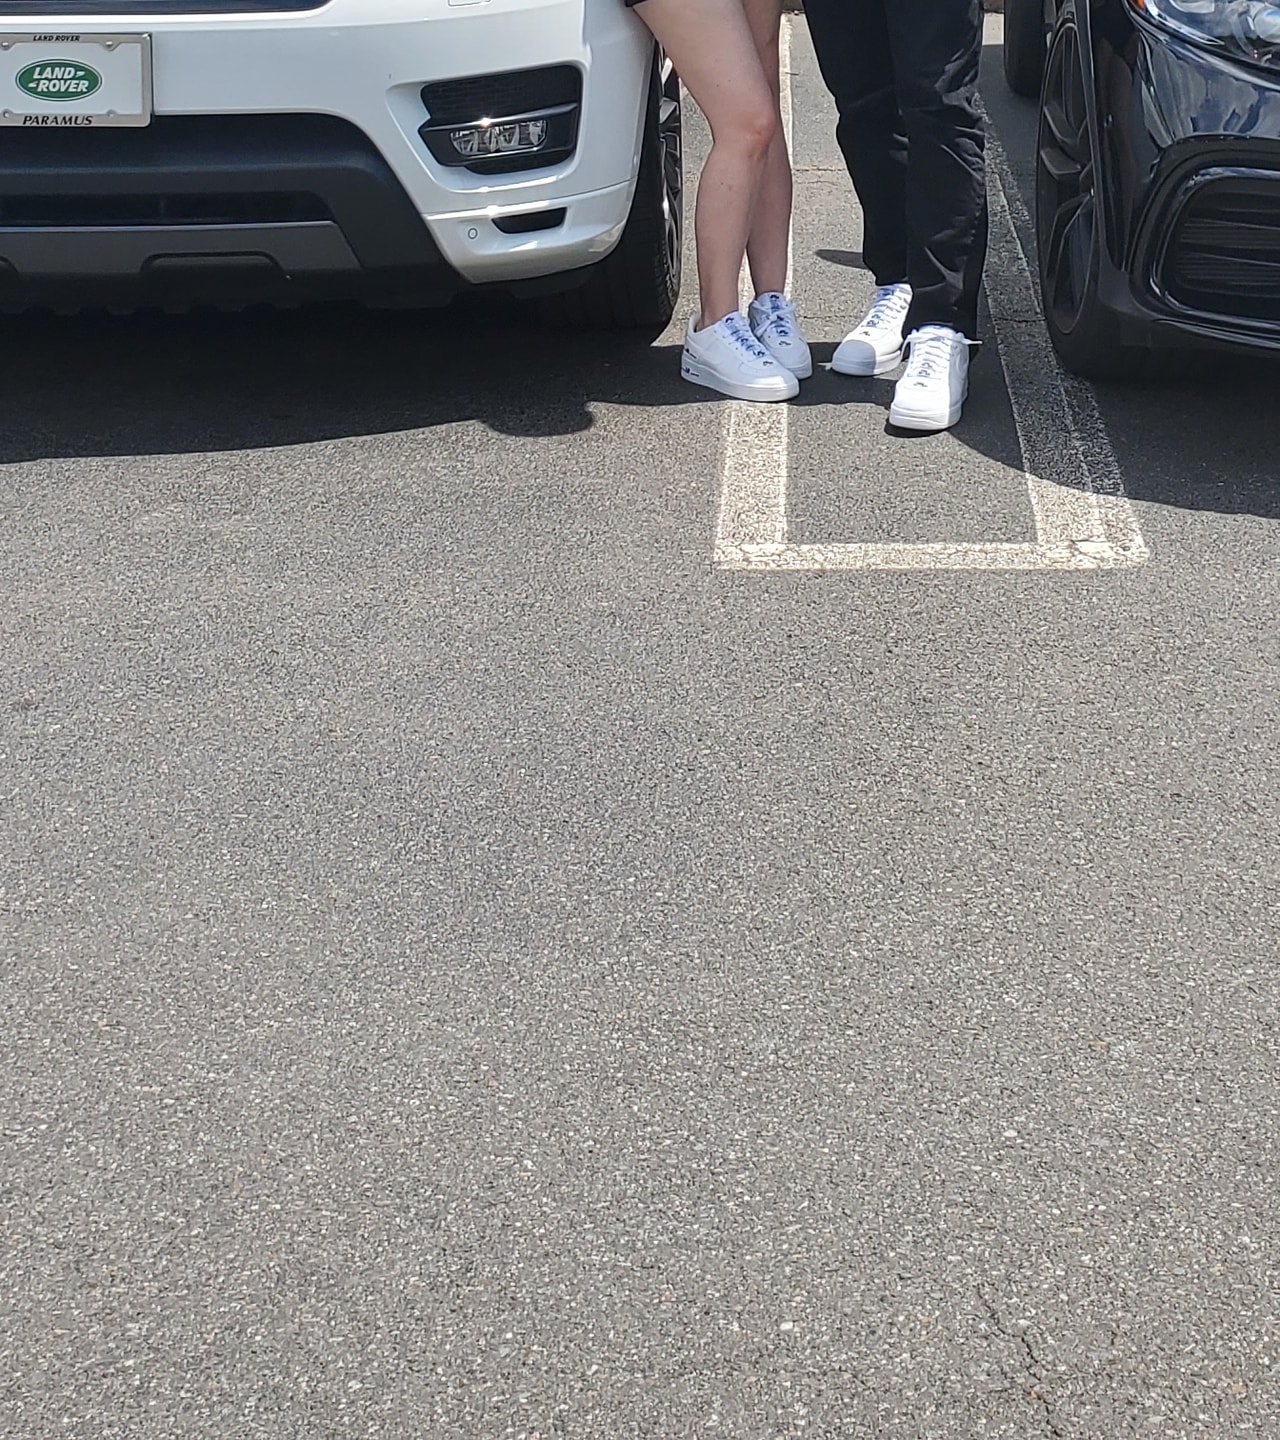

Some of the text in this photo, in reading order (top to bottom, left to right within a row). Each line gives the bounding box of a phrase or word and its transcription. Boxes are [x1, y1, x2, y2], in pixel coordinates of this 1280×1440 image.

[33, 67, 75, 79] LAND
[37, 80, 90, 92] ROVER
[22, 115, 94, 126] PARAMUS
